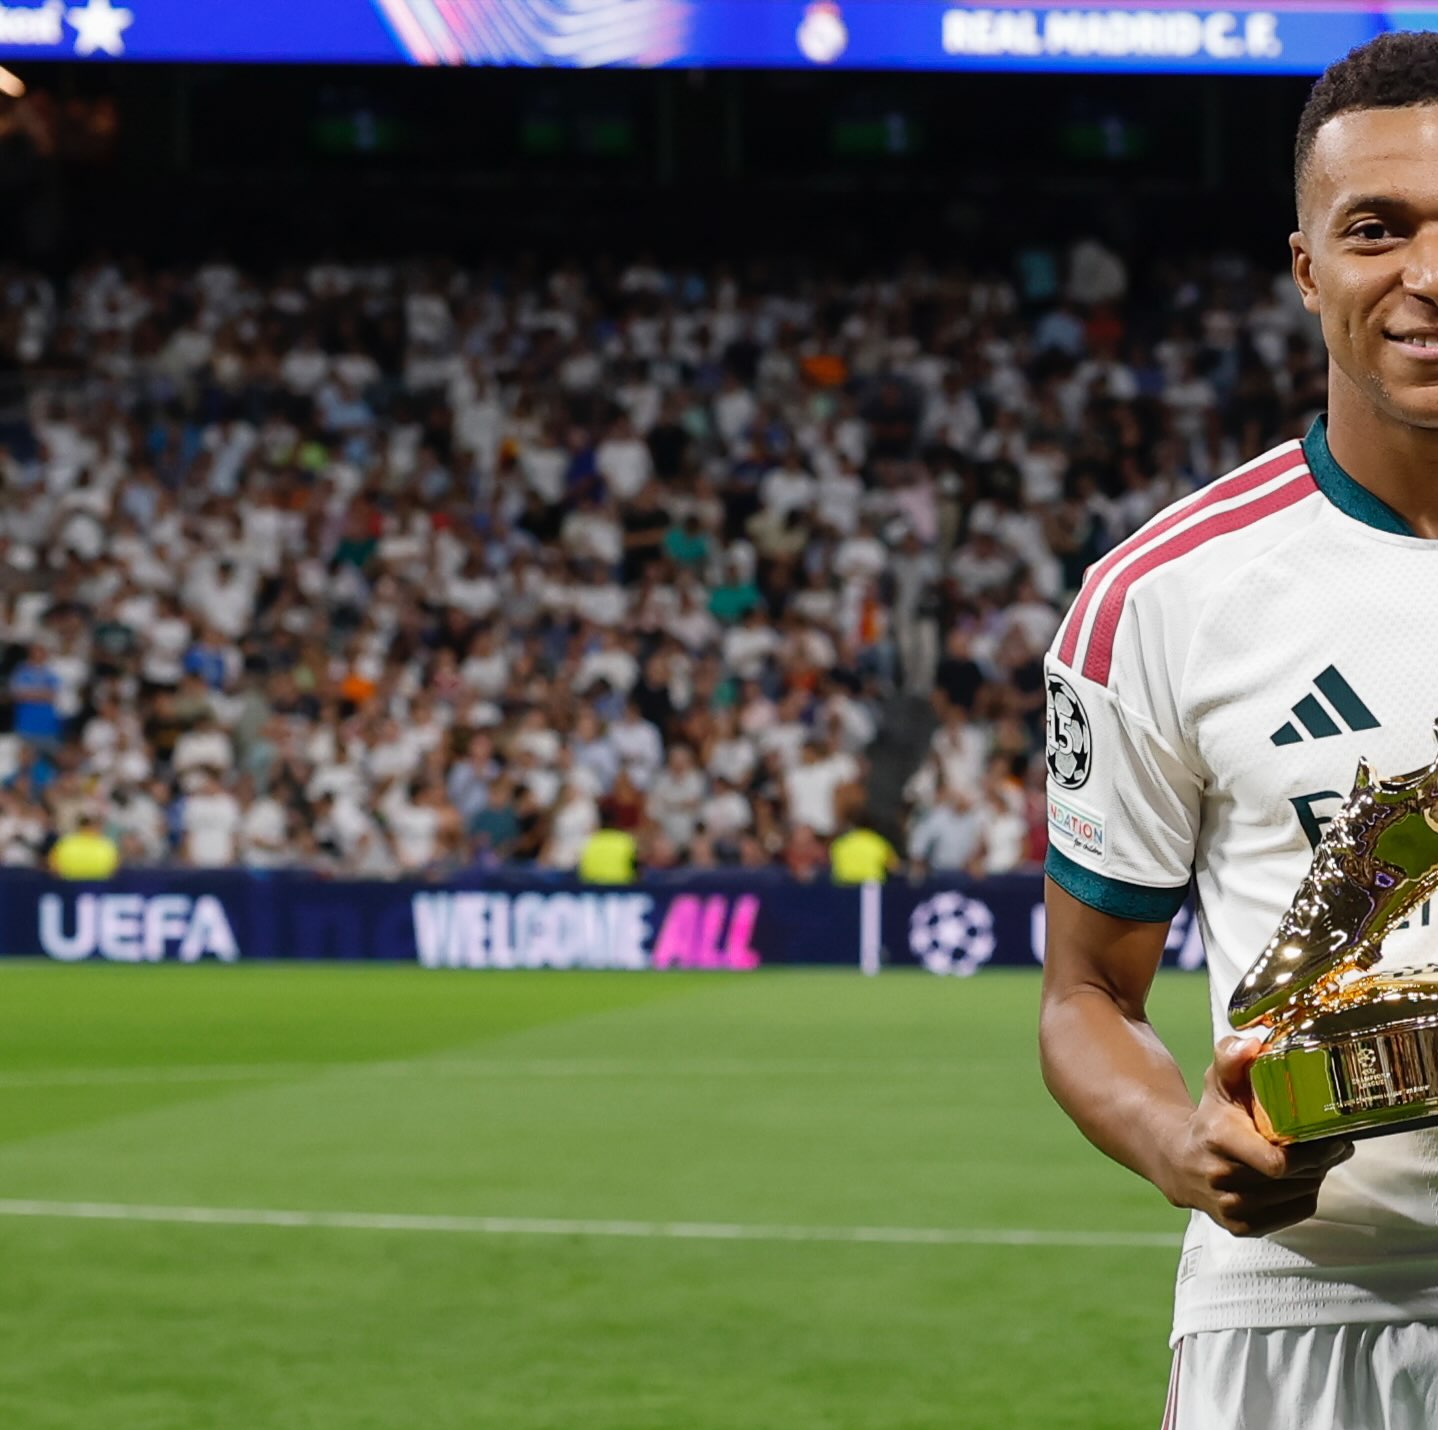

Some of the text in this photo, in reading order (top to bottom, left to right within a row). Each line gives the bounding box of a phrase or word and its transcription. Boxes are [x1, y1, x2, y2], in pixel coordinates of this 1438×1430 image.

[942, 9, 1043, 56] REAL
[1045, 10, 1202, 57] MADRID
[38, 893, 240, 963] UEFA
[412, 891, 653, 969] WELCOME
[652, 893, 761, 970] ALL
